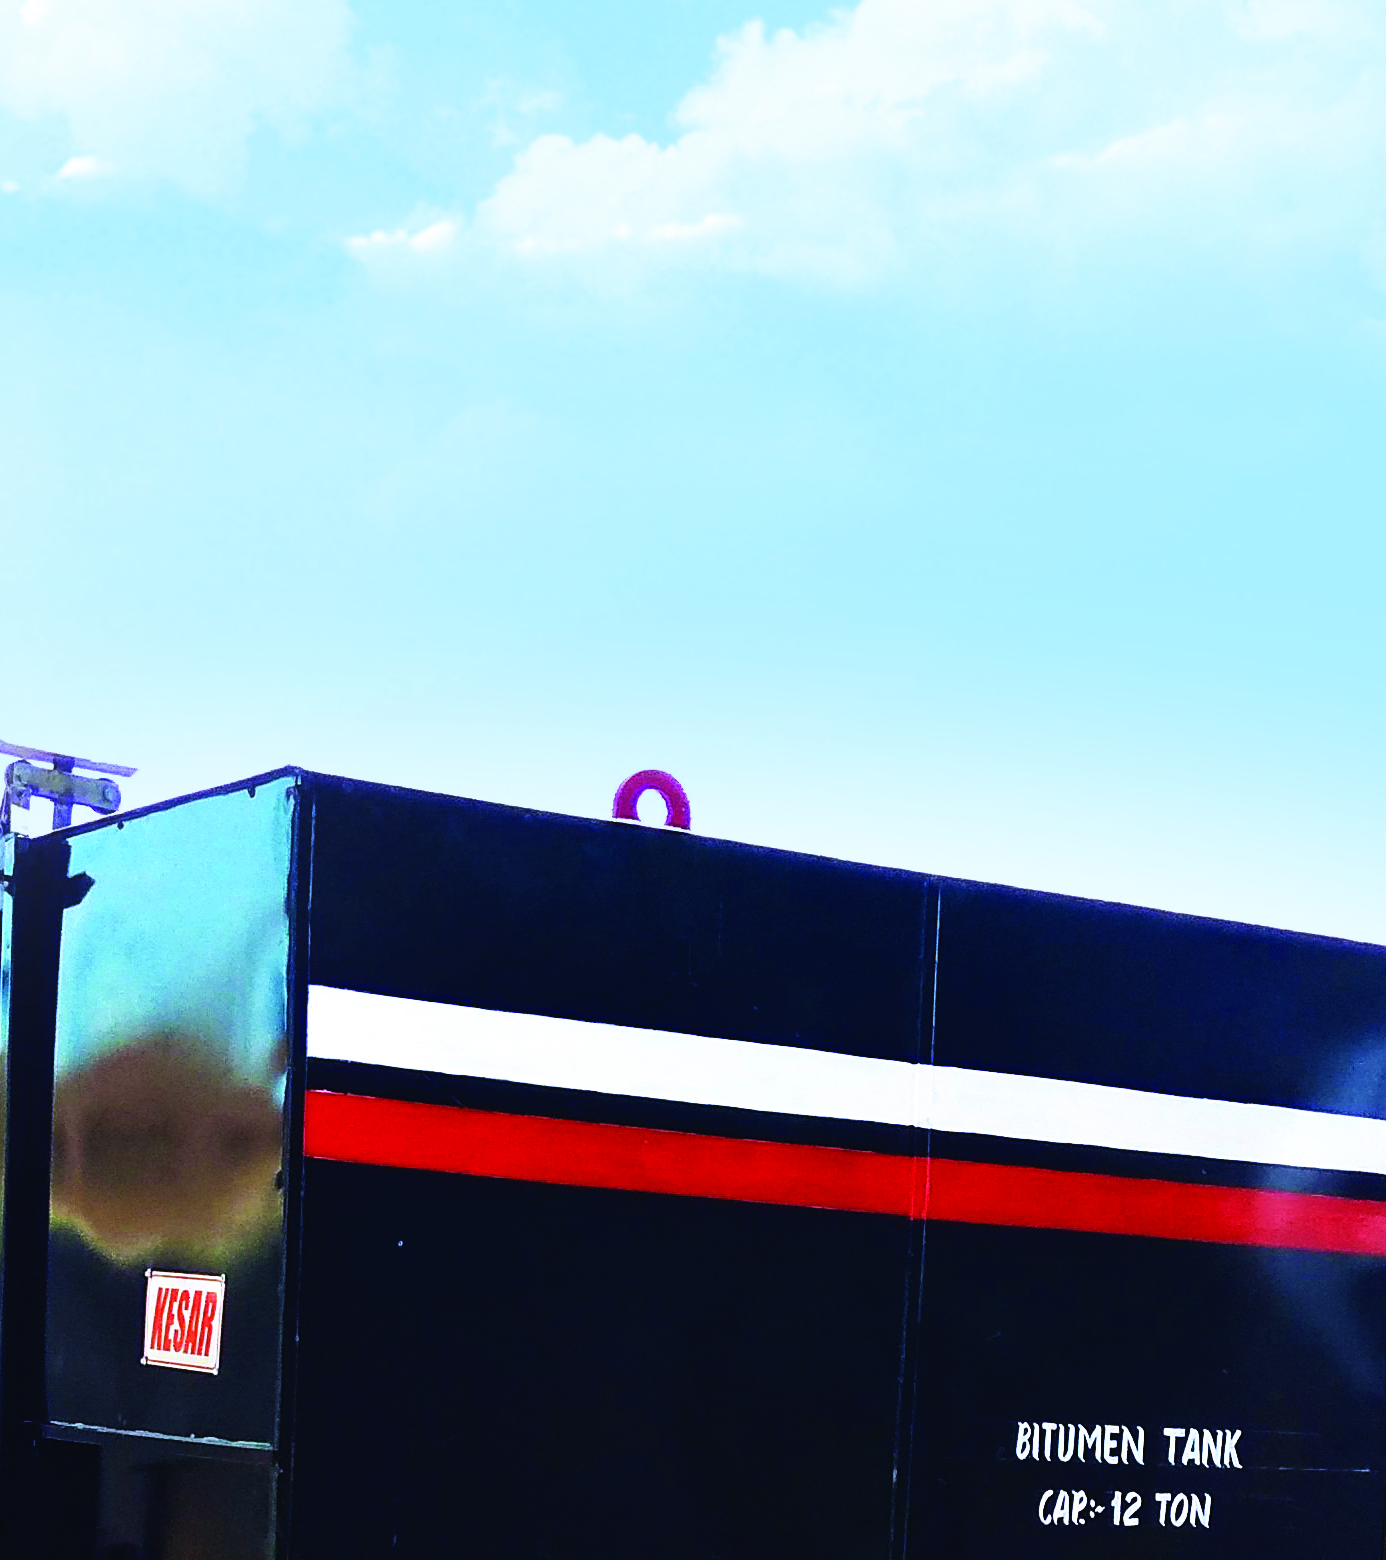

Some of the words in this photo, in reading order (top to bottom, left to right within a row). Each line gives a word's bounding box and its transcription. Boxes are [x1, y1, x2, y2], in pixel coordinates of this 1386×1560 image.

[150, 1287, 217, 1357] KESAR
[1015, 1421, 1145, 1466] BITUMEN
[1163, 1427, 1243, 1469] TANK
[1111, 1490, 1142, 1527] 12
[1155, 1492, 1212, 1529] TON
